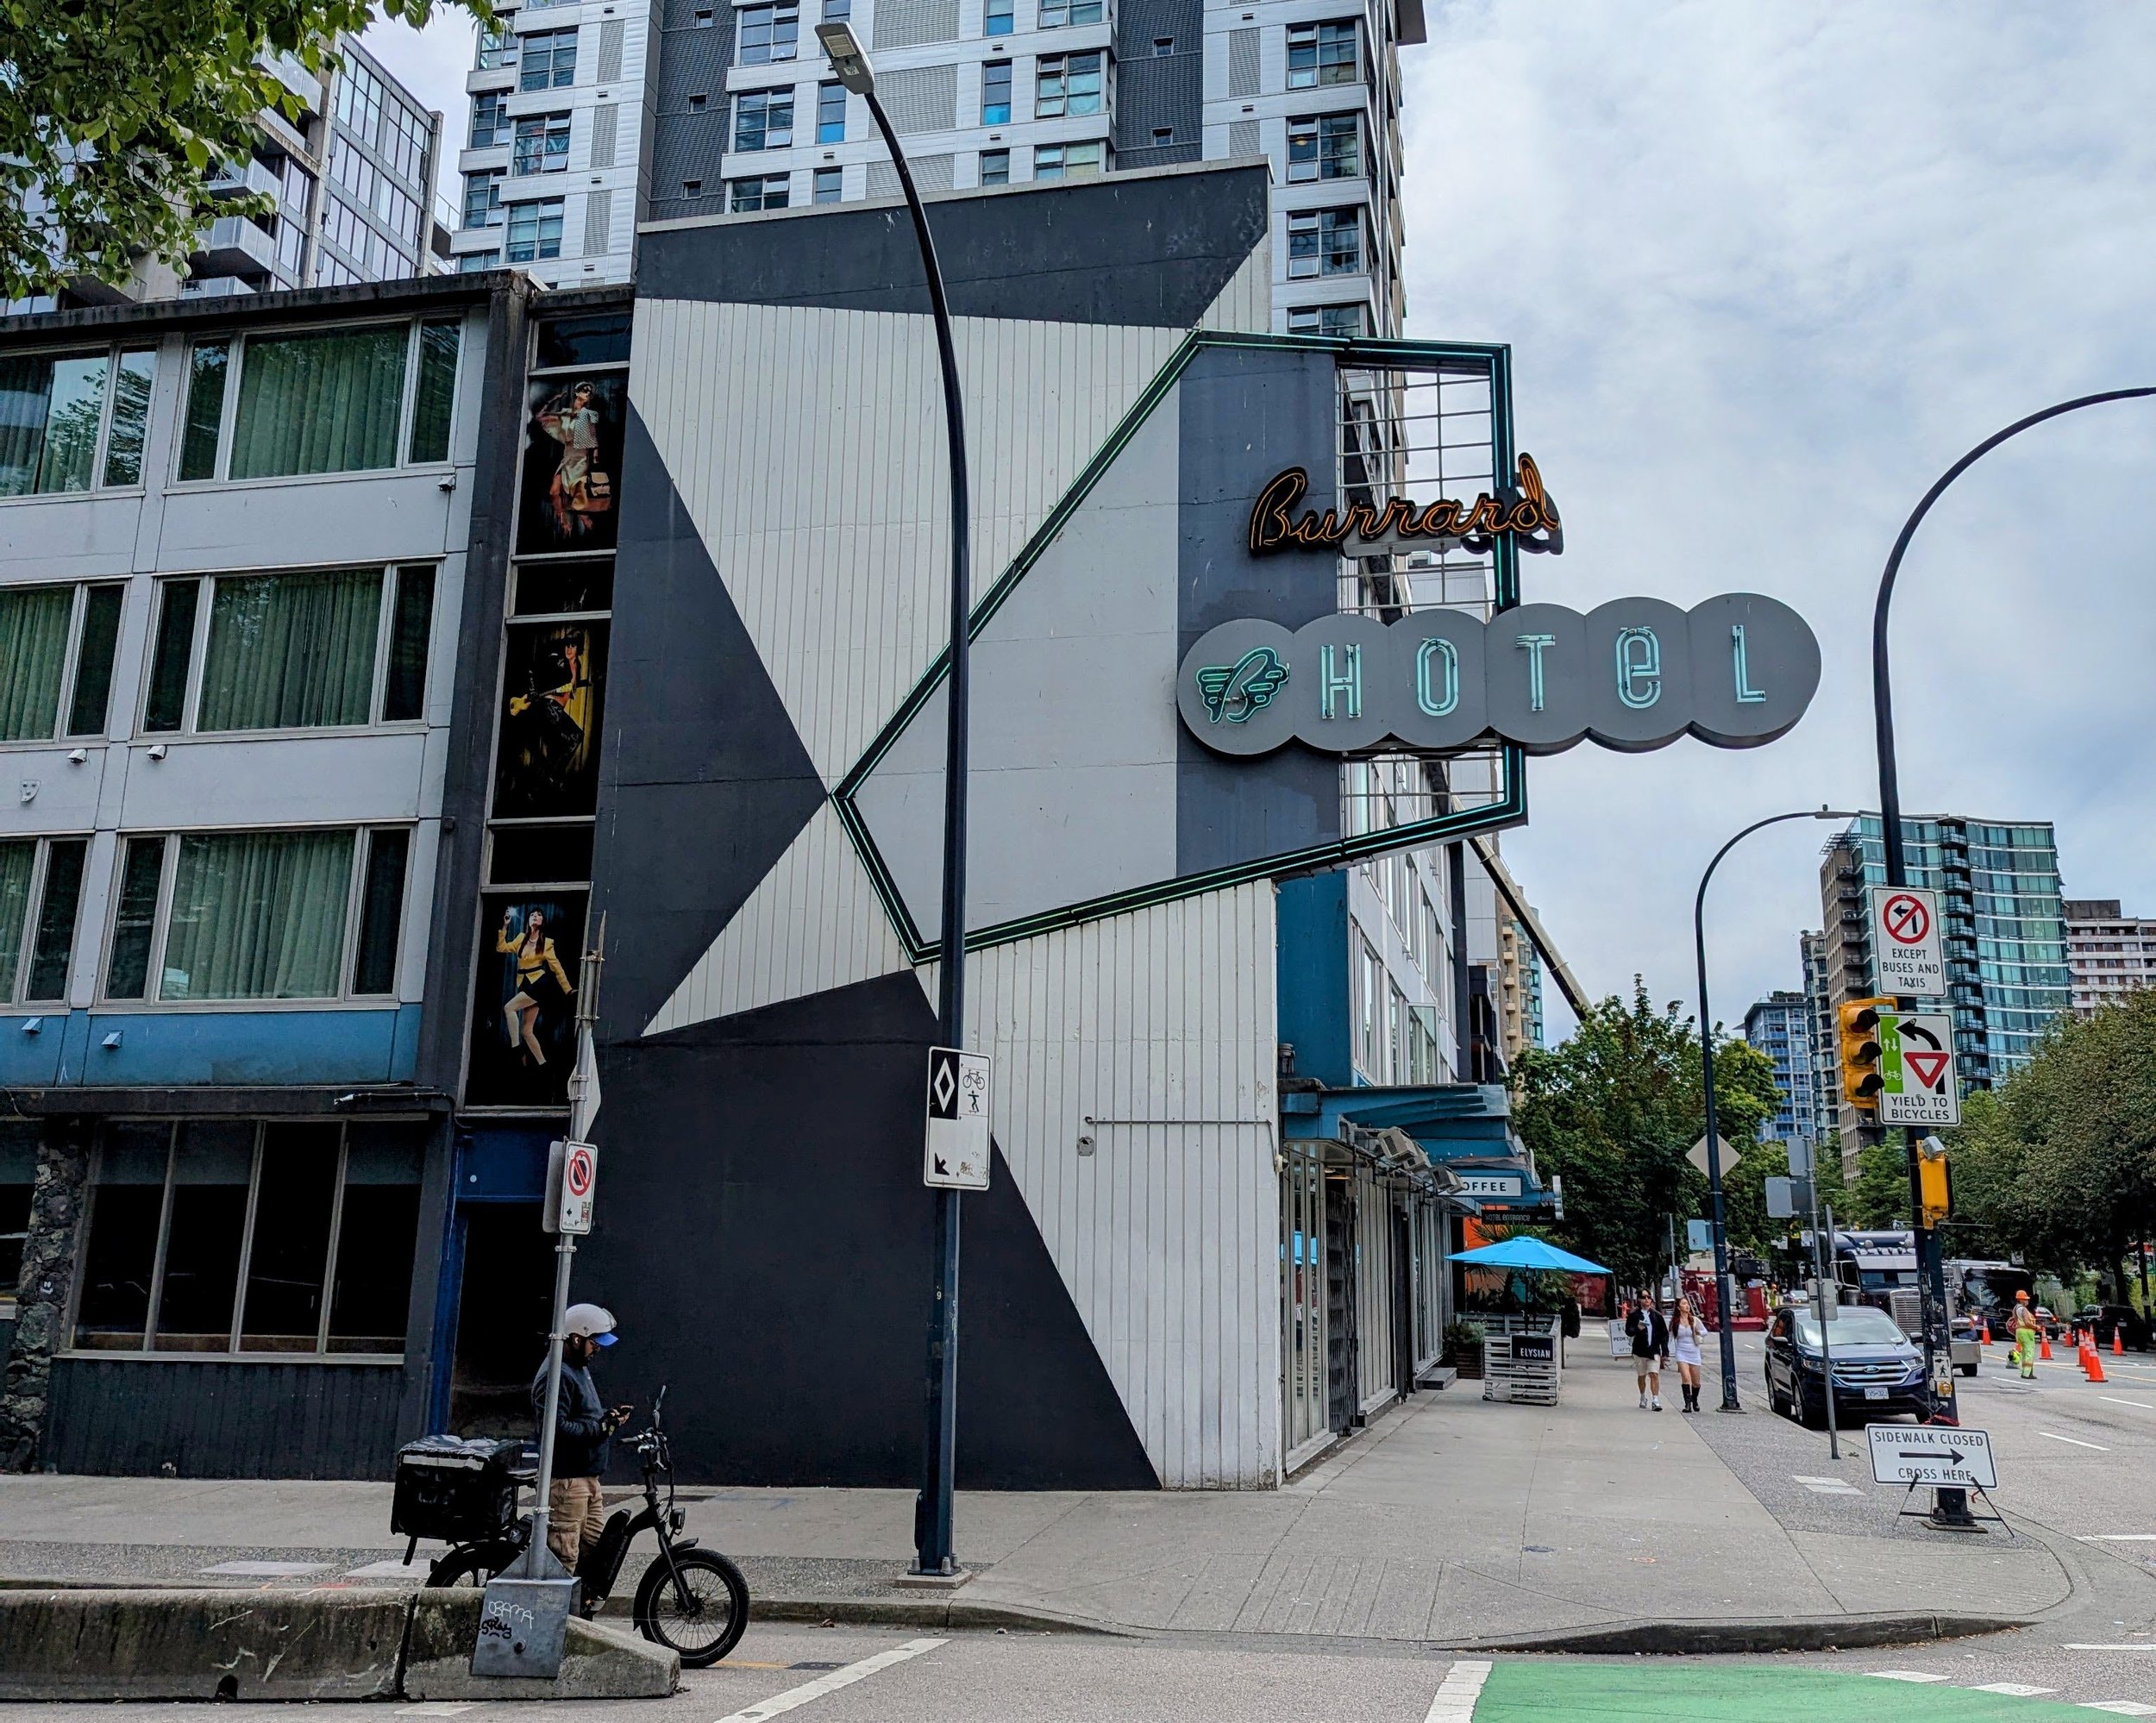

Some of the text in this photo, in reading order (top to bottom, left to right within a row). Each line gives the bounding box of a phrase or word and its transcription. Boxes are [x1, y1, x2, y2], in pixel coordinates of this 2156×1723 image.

[1250, 453, 1559, 555] Burrard
[1892, 949, 1927, 960] EXCEPT
[1883, 962, 1940, 974] BUSES AND
[1898, 977, 1926, 987] TAXIS
[1891, 1096, 1948, 1107] YIELD TO
[1891, 1109, 1950, 1120] BICYCLES
[1463, 1181, 1507, 1192] OFFEE
[1520, 1347, 1551, 1358] ELYSIAN
[1875, 1432, 1984, 1446] SIDEWALK CLOSED
[1898, 1468, 1972, 1481] CROSS HERE
